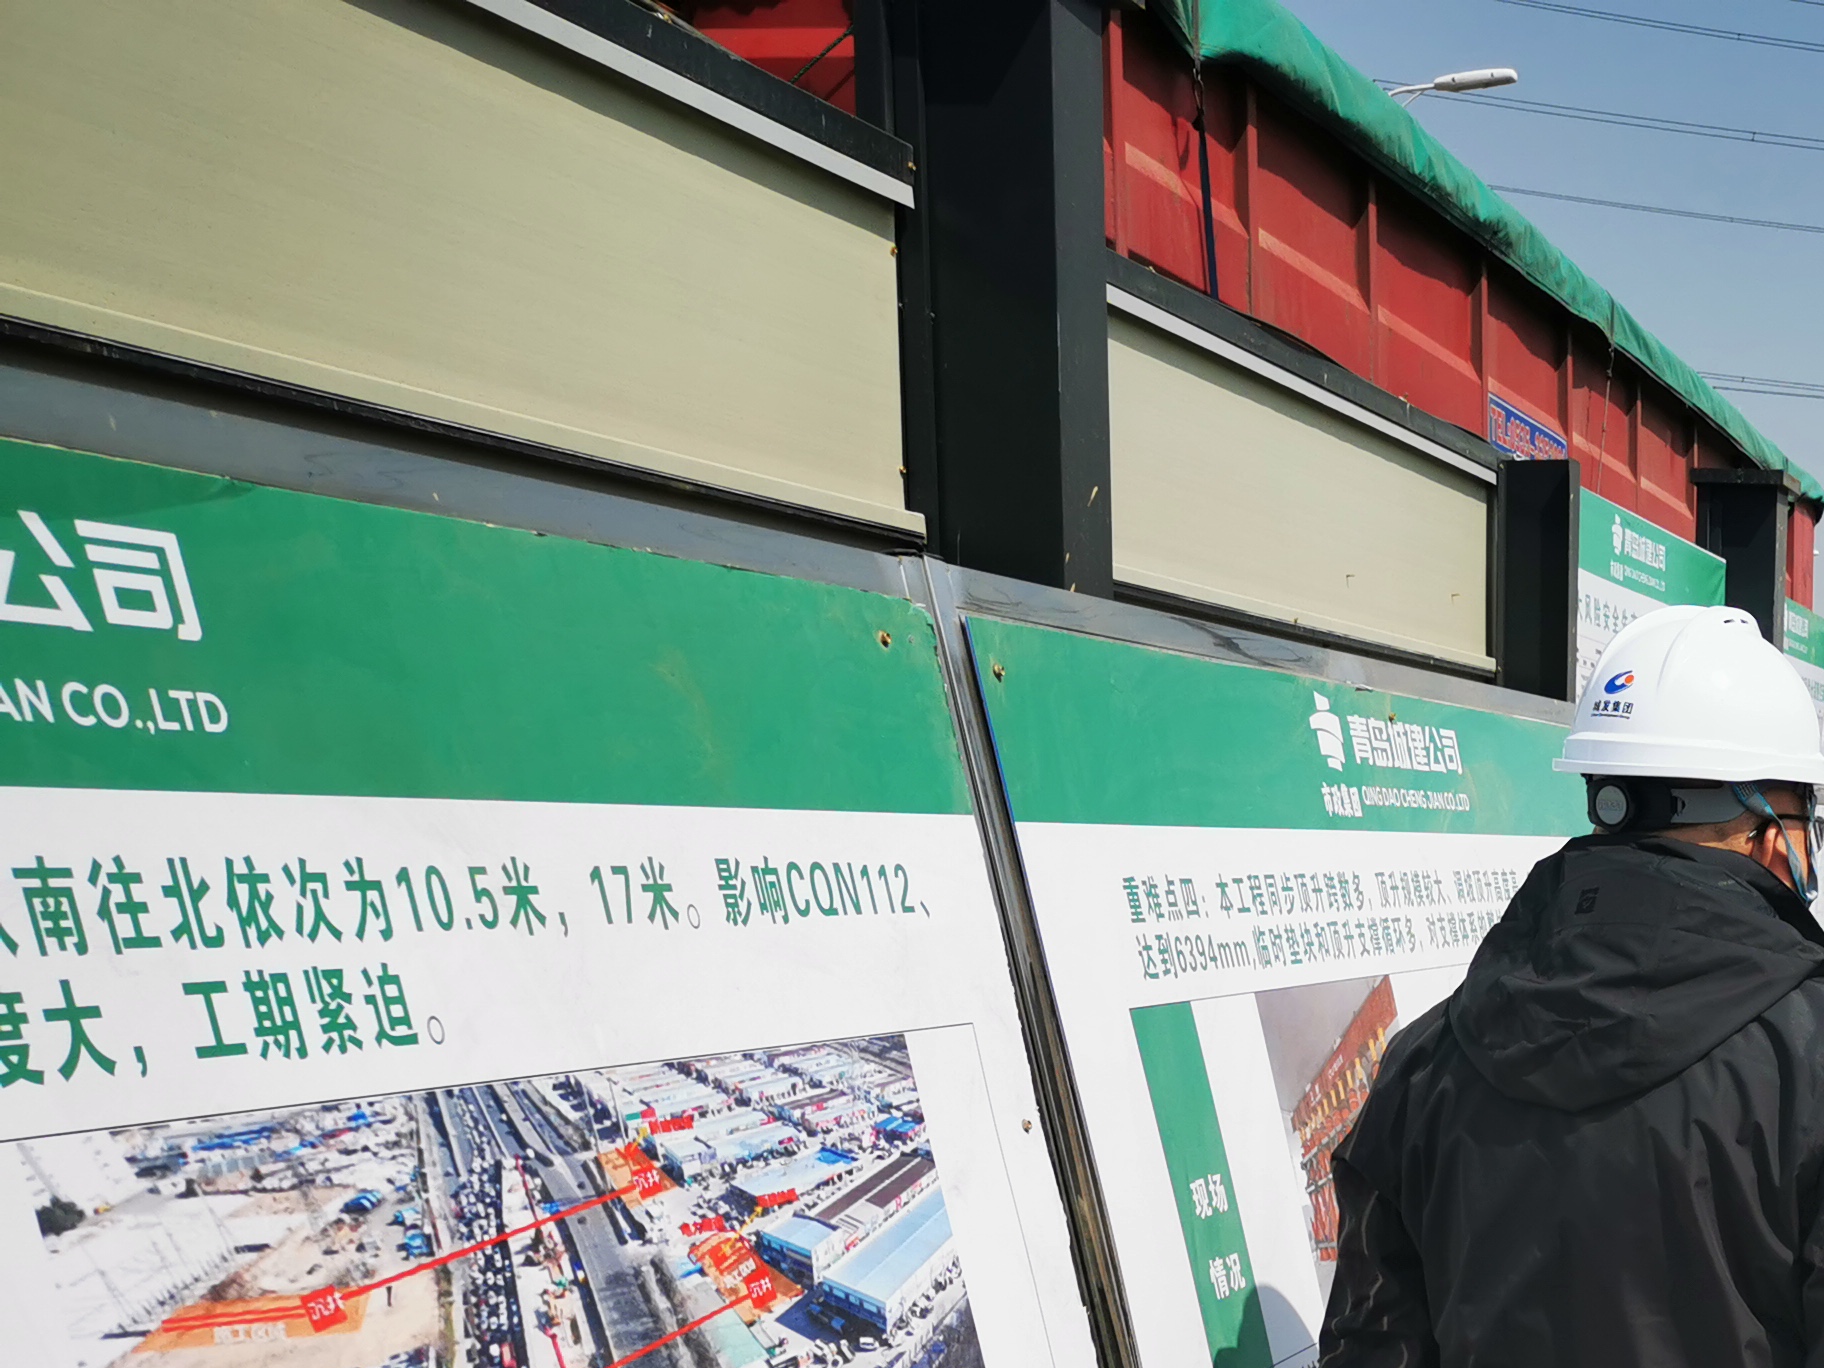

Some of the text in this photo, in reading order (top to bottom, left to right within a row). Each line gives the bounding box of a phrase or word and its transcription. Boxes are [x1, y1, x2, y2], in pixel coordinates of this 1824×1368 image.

[0, 509, 203, 642] 公司
[1346, 714, 1464, 776] 青岛城建公司
[1321, 781, 1364, 818] 市政集团
[1189, 1173, 1229, 1220] 现场
[1208, 1252, 1247, 1301] 情况
